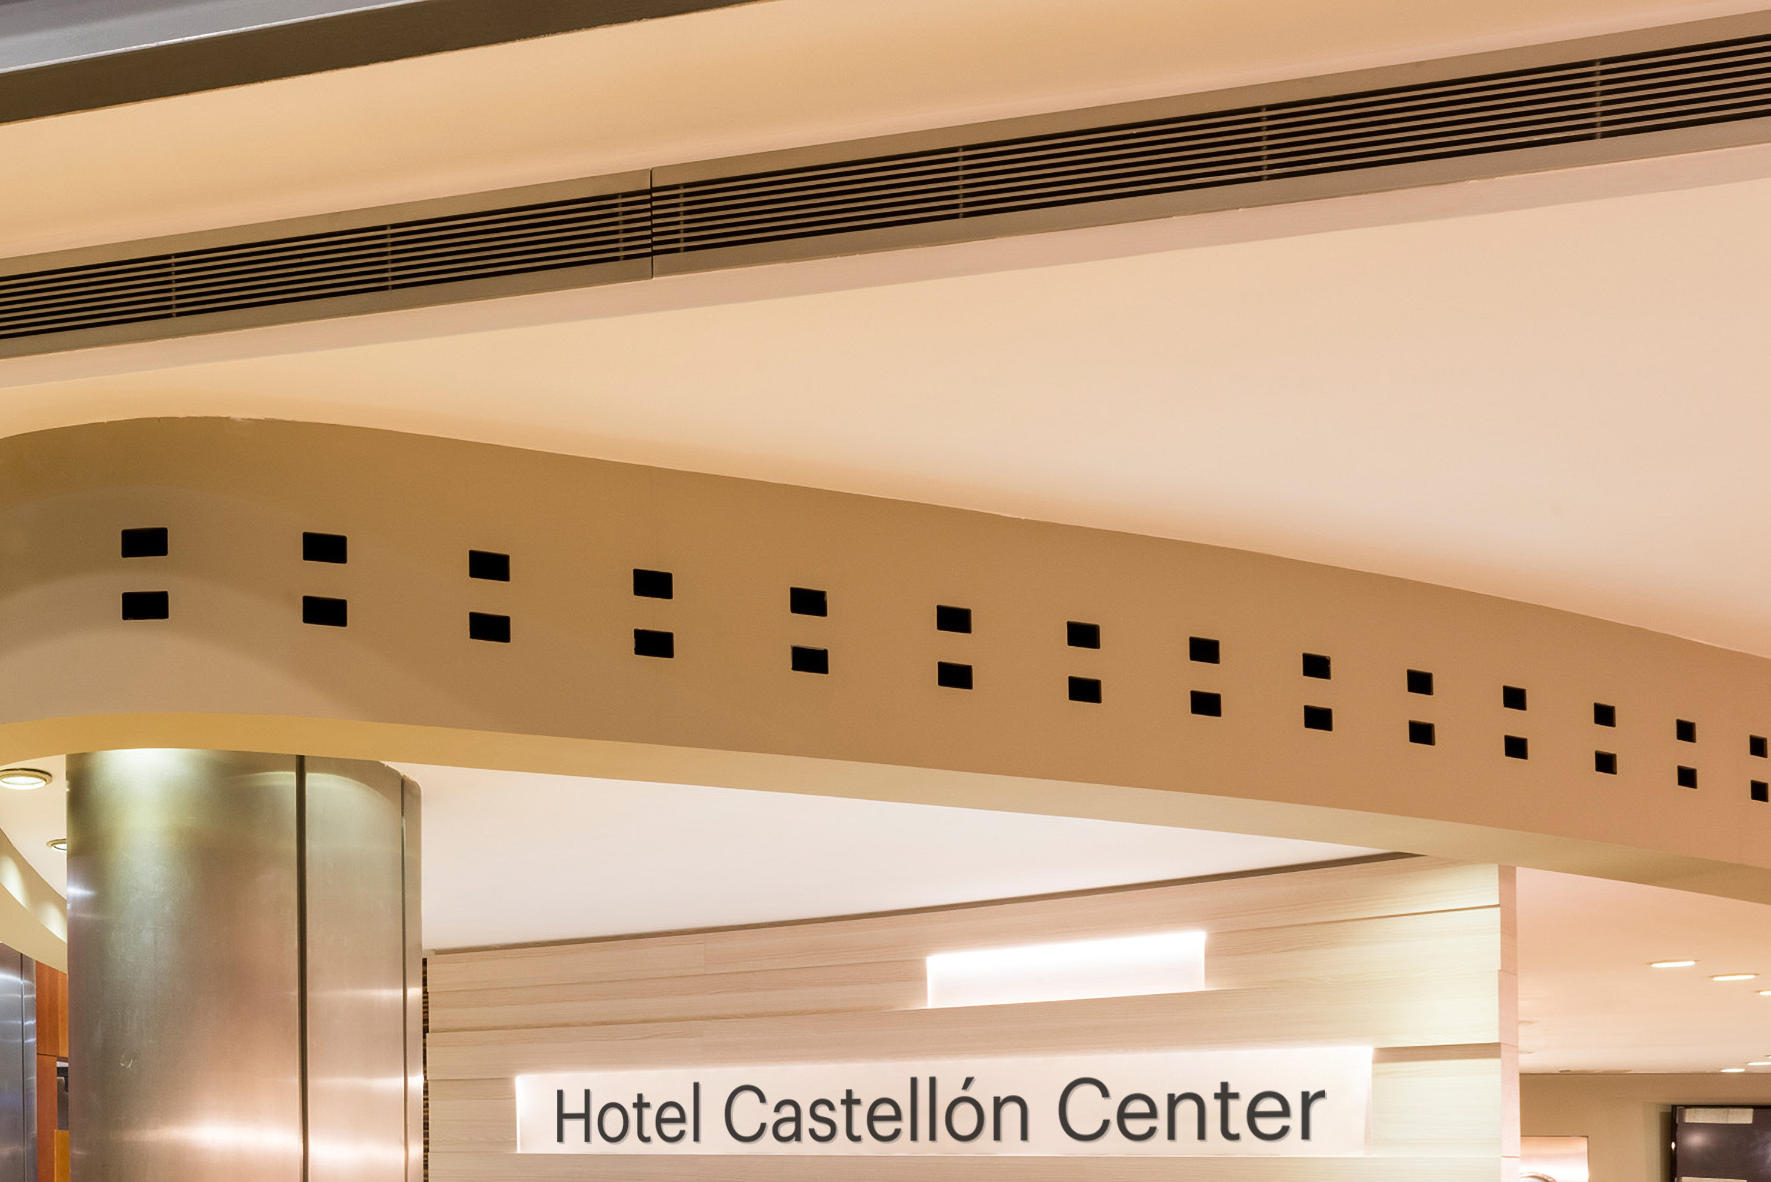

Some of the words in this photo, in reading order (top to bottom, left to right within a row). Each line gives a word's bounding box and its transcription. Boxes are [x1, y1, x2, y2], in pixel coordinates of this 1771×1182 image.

[555, 1081, 702, 1145] Hotel
[723, 1075, 1030, 1144] Castellón
[1057, 1076, 1328, 1143] Center
